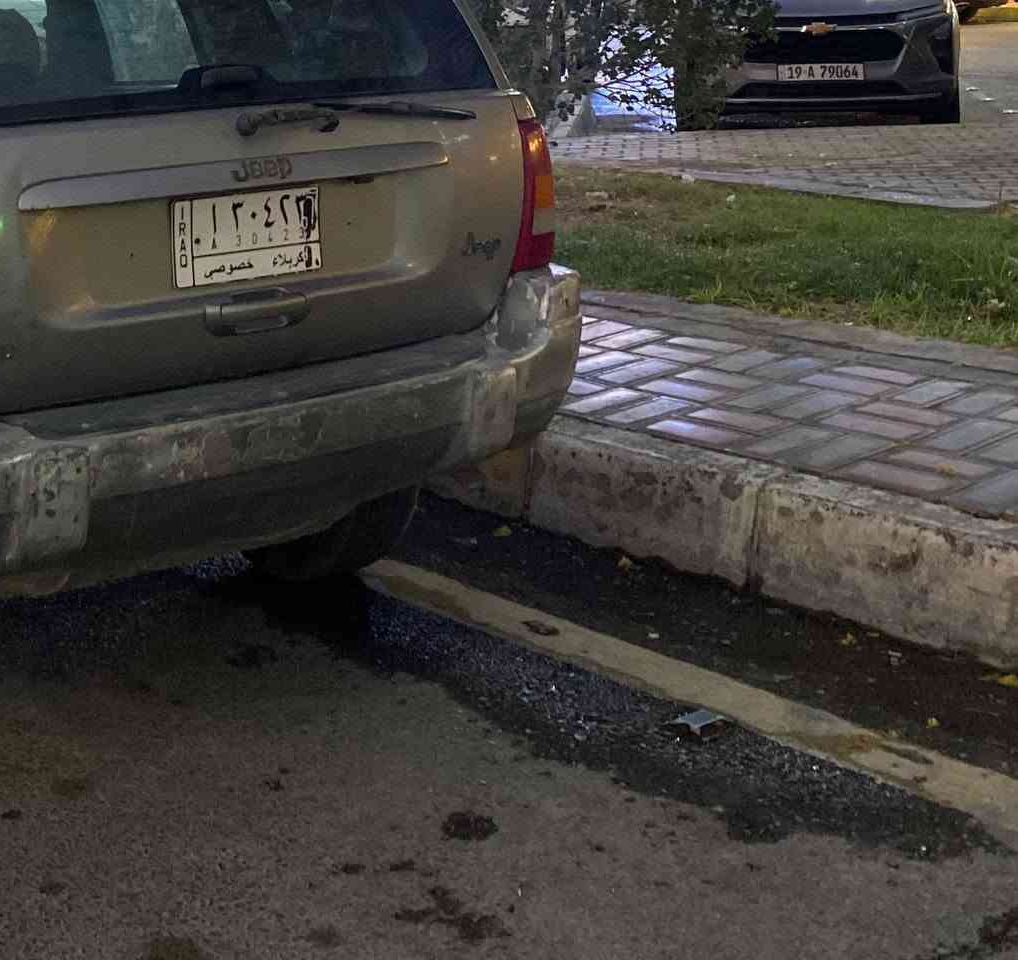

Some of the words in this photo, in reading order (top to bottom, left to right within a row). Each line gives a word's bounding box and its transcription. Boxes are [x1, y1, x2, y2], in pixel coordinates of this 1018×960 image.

[787, 66, 802, 79] 19
[807, 65, 815, 79] A
[820, 65, 859, 79] 79064
[178, 206, 188, 269] IRAQ
